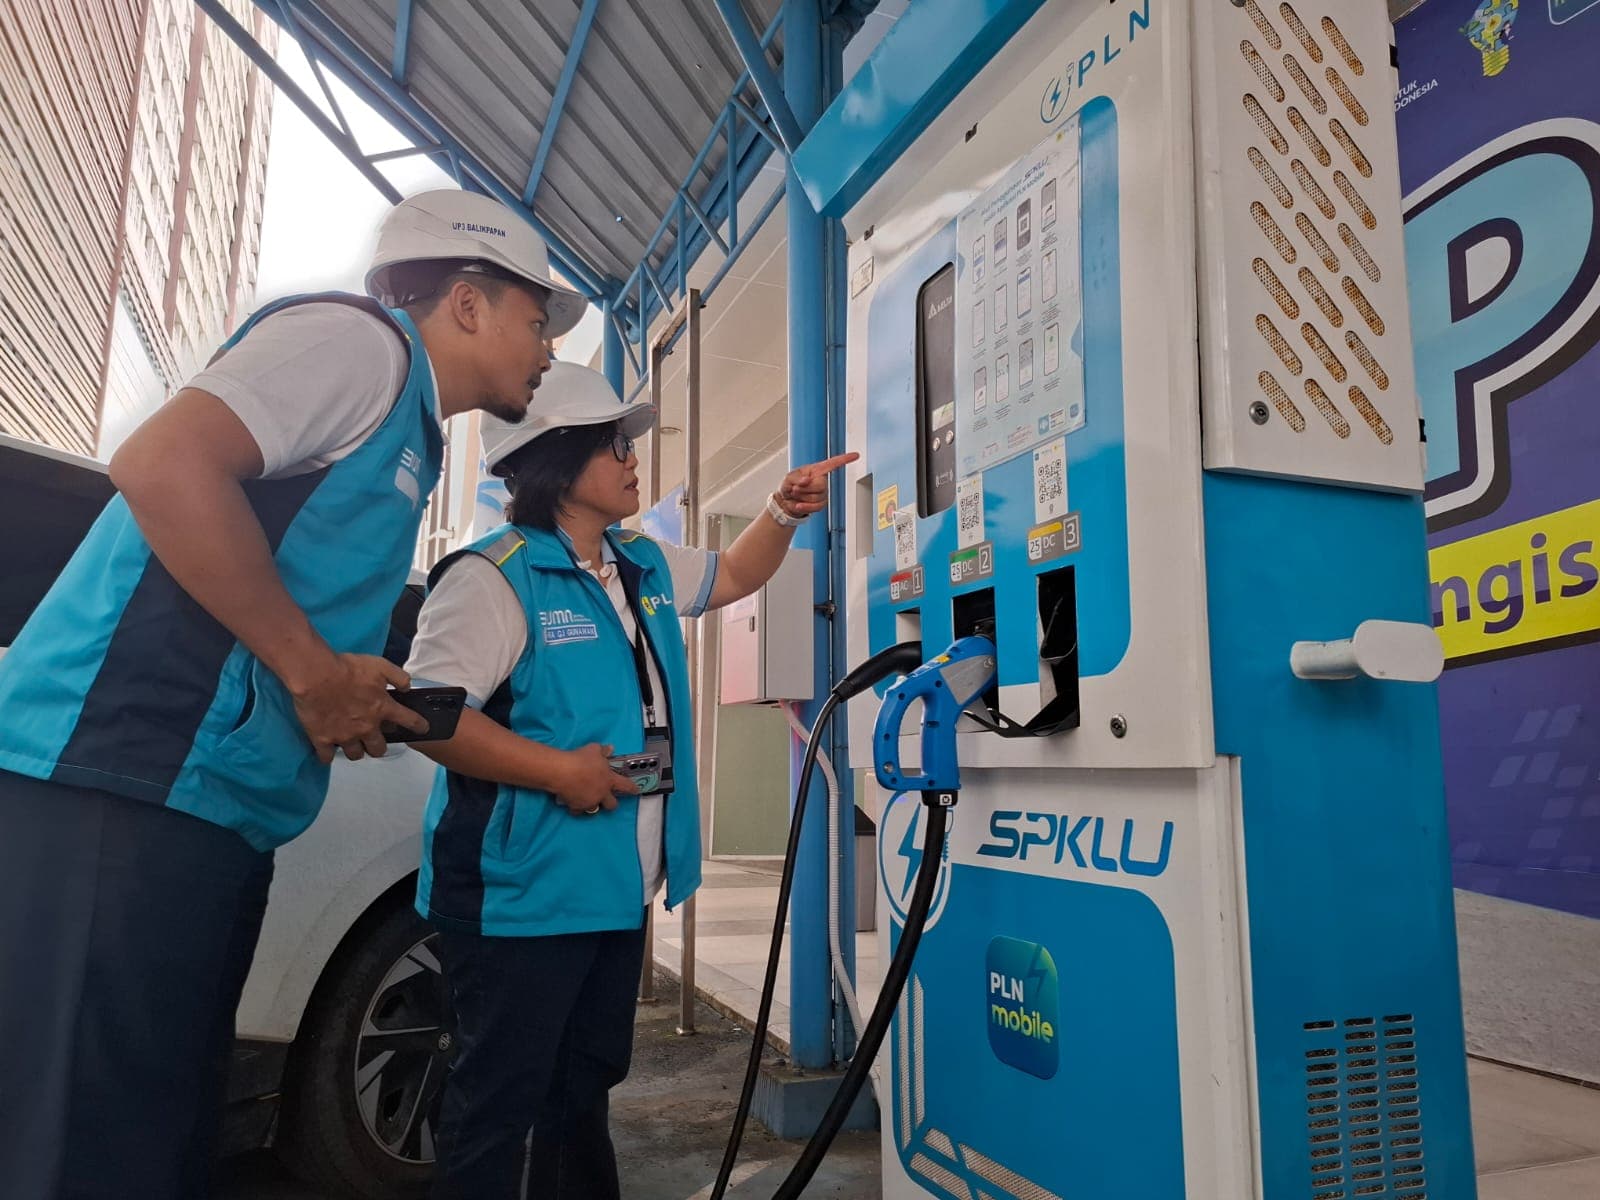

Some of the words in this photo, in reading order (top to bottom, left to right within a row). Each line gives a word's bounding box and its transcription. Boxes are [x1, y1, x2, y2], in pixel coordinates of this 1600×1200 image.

[1078, 0, 1150, 88] PLN
[452, 221, 466, 231] UP3
[467, 223, 506, 238] BALIKPAPAN
[1030, 541, 1040, 553] 25
[1042, 534, 1056, 549] DC
[1066, 522, 1076, 544] 3
[962, 559, 973, 573] DC
[981, 550, 989, 569] 2
[914, 571, 921, 590] 1
[1431, 532, 1600, 635] ngis
[976, 810, 1174, 877] SPKLU
[990, 971, 1024, 1002] PLN
[991, 1004, 1054, 1043] mobile
